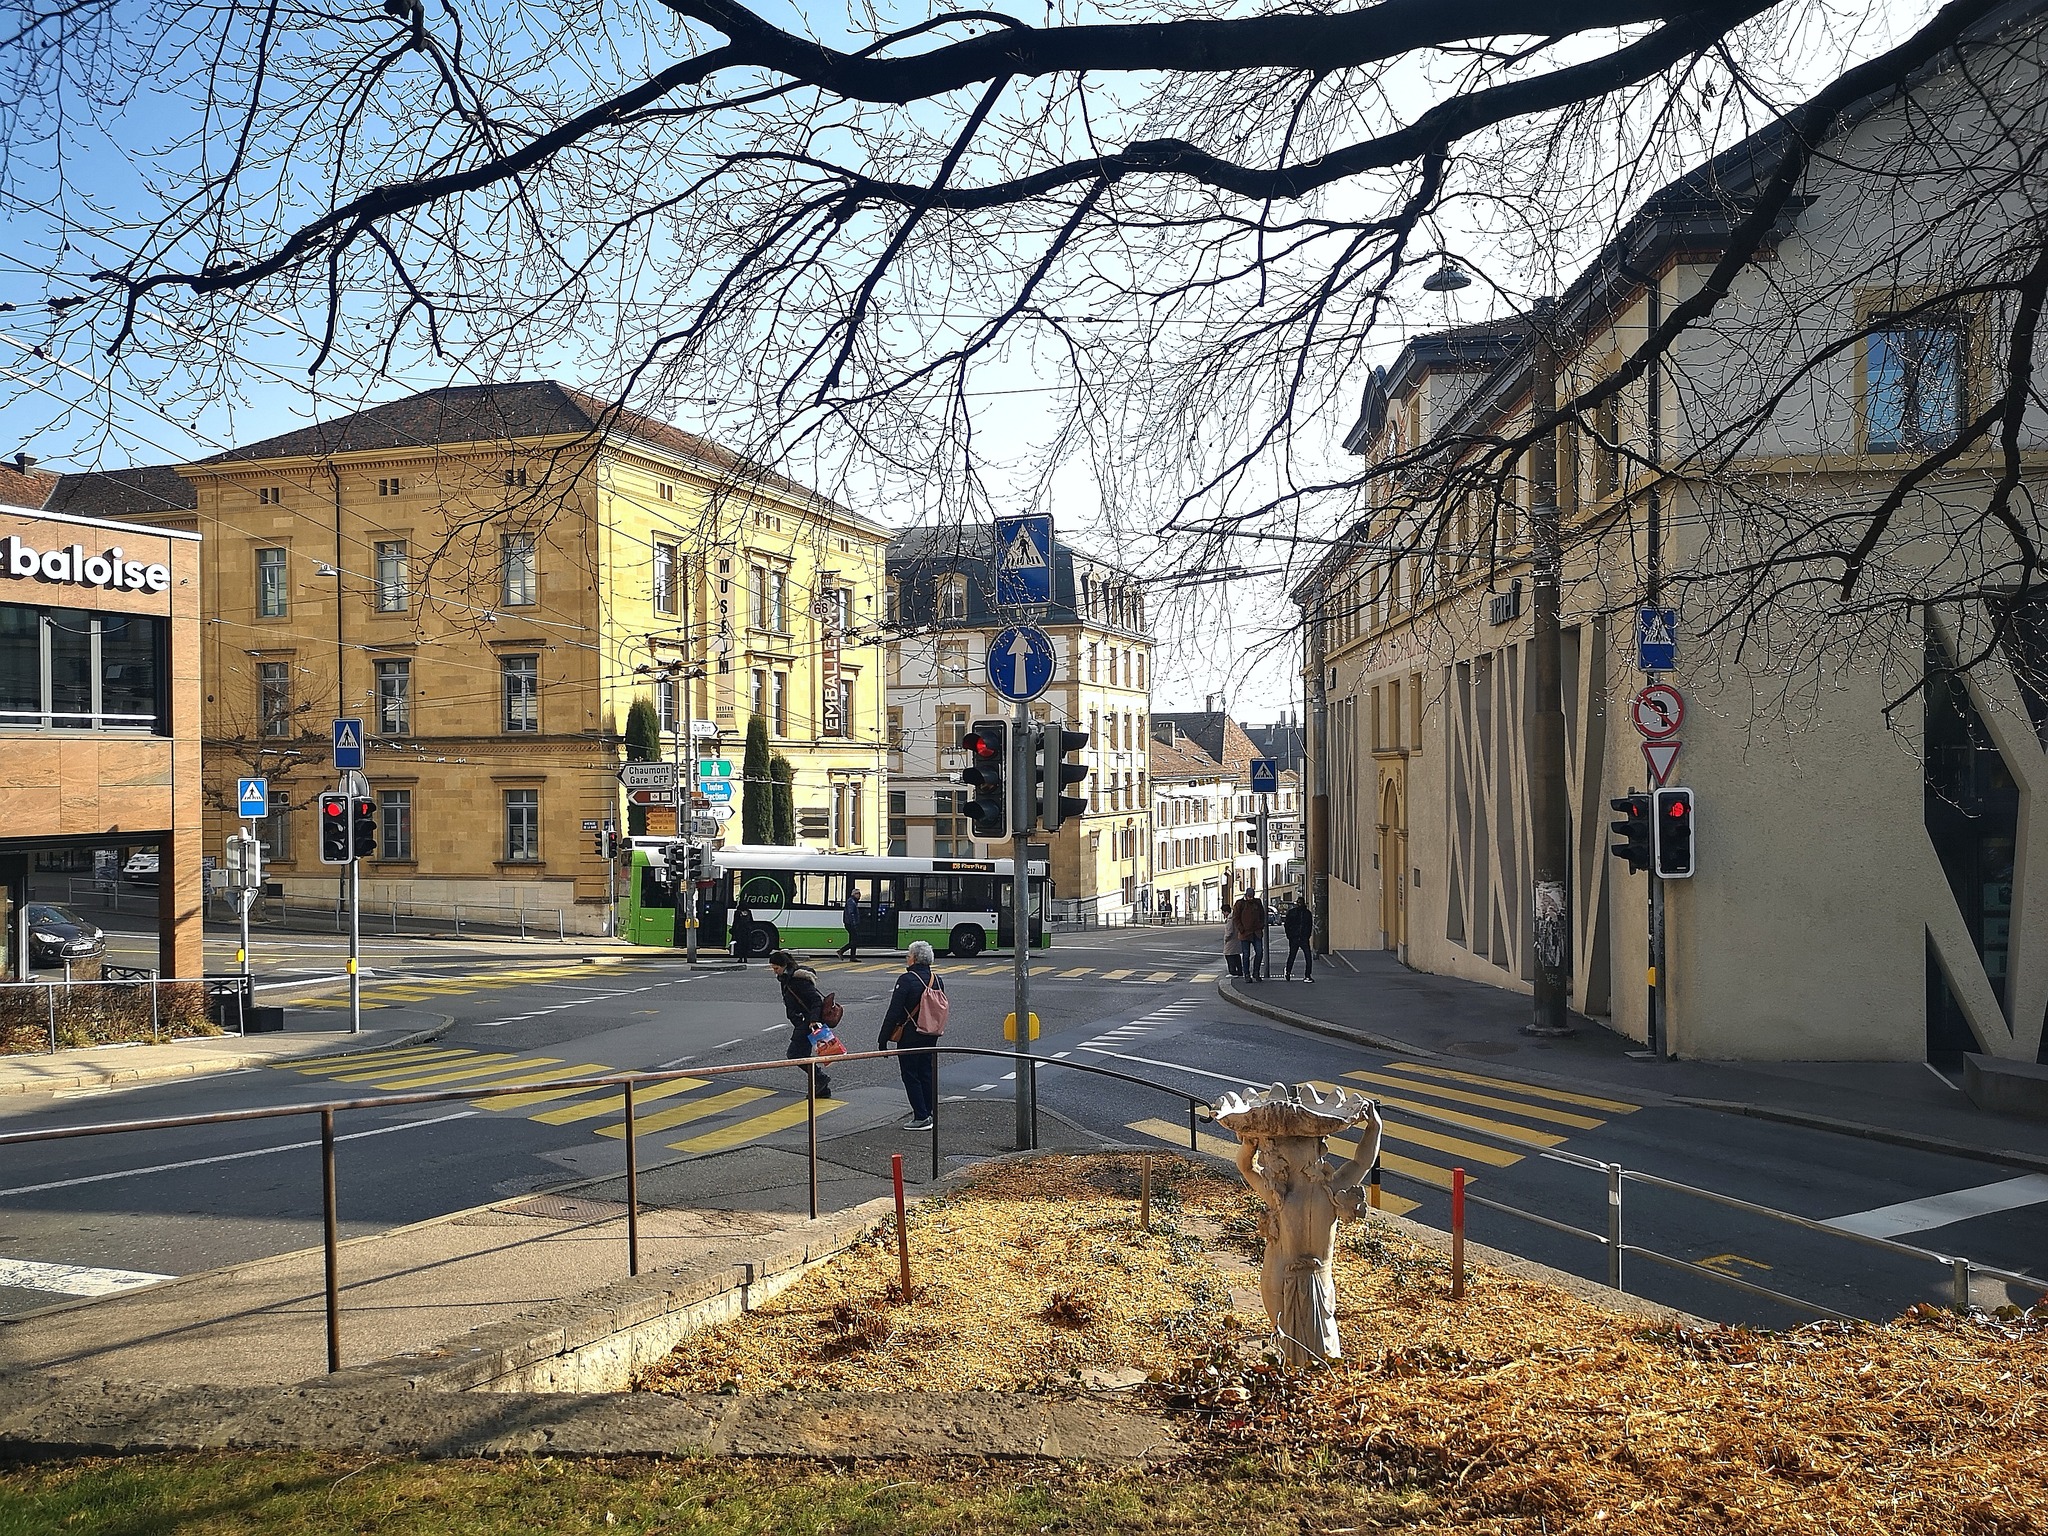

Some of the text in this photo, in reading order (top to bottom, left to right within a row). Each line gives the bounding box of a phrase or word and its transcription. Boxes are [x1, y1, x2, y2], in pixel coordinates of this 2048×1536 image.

[10, 535, 171, 592] baloise
[814, 602, 829, 615] 68
[628, 765, 670, 775] Chaumont
[629, 775, 669, 785] Gare CFF
[706, 783, 724, 791] Toutes
[712, 809, 725, 818] Pury
[743, 893, 779, 904] transN
[909, 913, 943, 924] transN
